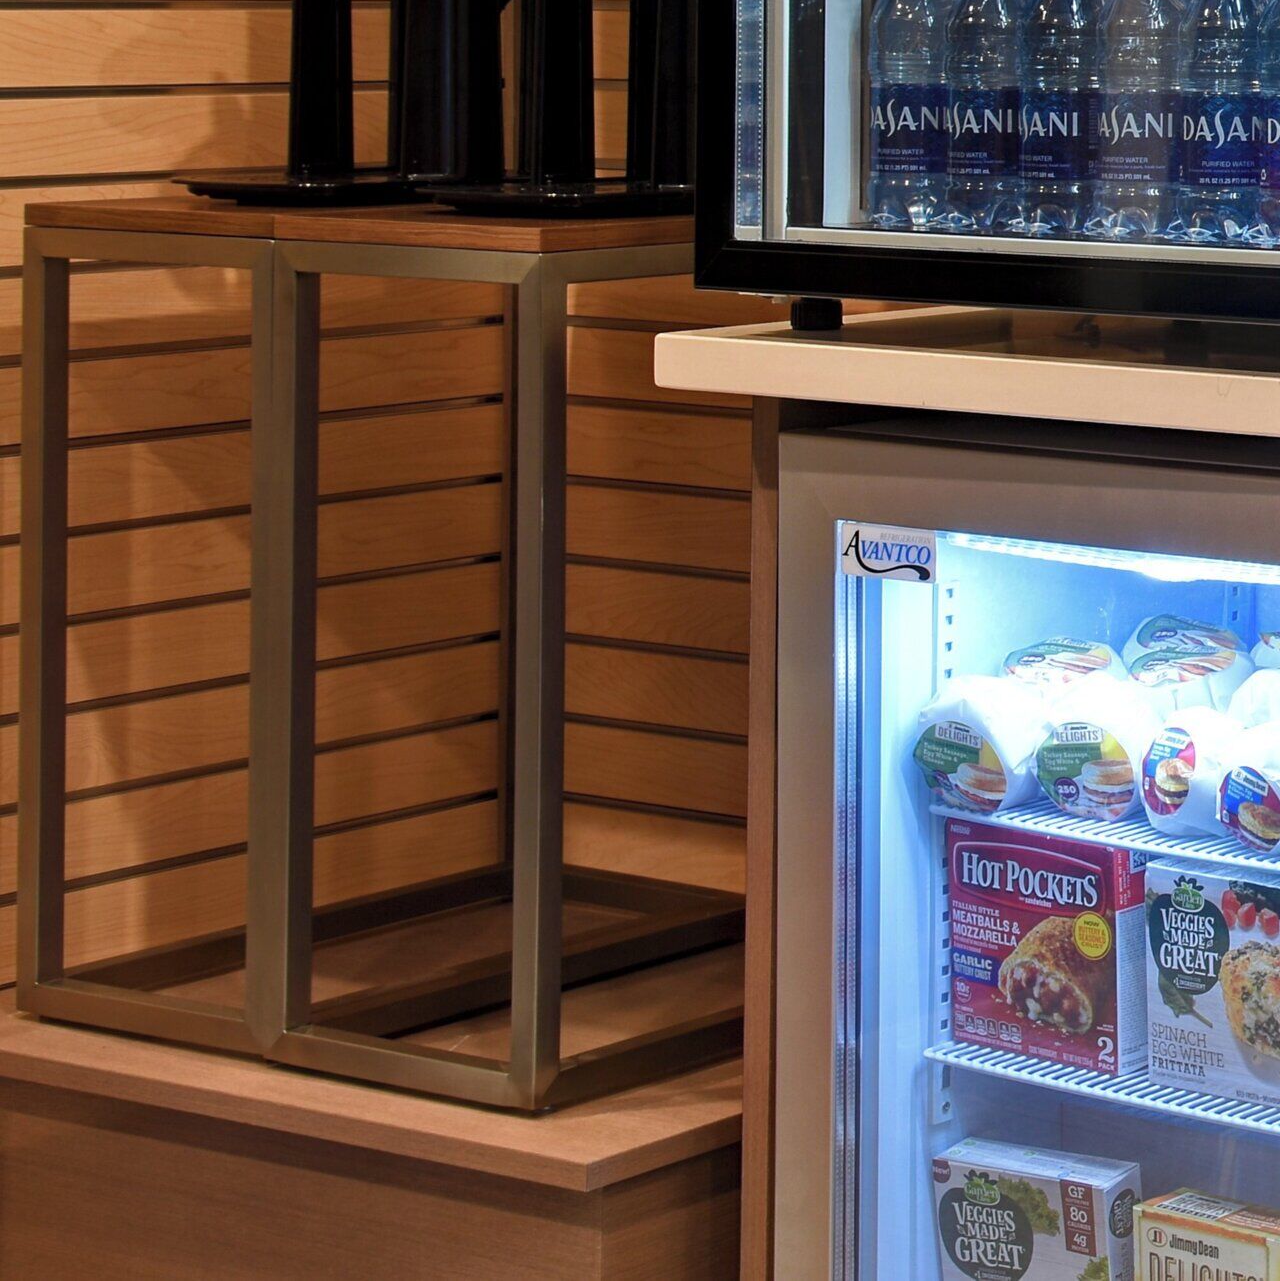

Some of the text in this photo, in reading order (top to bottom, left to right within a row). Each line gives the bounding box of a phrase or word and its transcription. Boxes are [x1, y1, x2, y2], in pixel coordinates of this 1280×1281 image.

[962, 852, 1003, 889] HOT
[1006, 860, 1098, 907] POCKETS
[953, 901, 999, 916] ITALIAN STYLE
[953, 910, 1020, 934] MEATBALLS &
[1161, 908, 1214, 939] VEGGIES
[953, 923, 1017, 946] MOZZARELLA
[1170, 929, 1205, 949] MADE
[953, 953, 992, 969] GARLIC
[1160, 944, 1218, 977] GREAT
[1152, 1023, 1207, 1048] SPINACH
[1098, 1037, 1114, 1063] 2
[1152, 1039, 1224, 1068] EGG WHITE
[1098, 1062, 1114, 1070] PACK
[1152, 1056, 1205, 1077] FRITTATA
[1068, 1186, 1085, 1199] GF
[952, 1202, 1015, 1232] VEGGIES
[1070, 1207, 1087, 1222] 80
[966, 1224, 1007, 1242] MADE
[1073, 1233, 1086, 1247] 4g
[955, 1237, 1023, 1270] GREAT
[1170, 1234, 1219, 1258] Jimmy Dean
